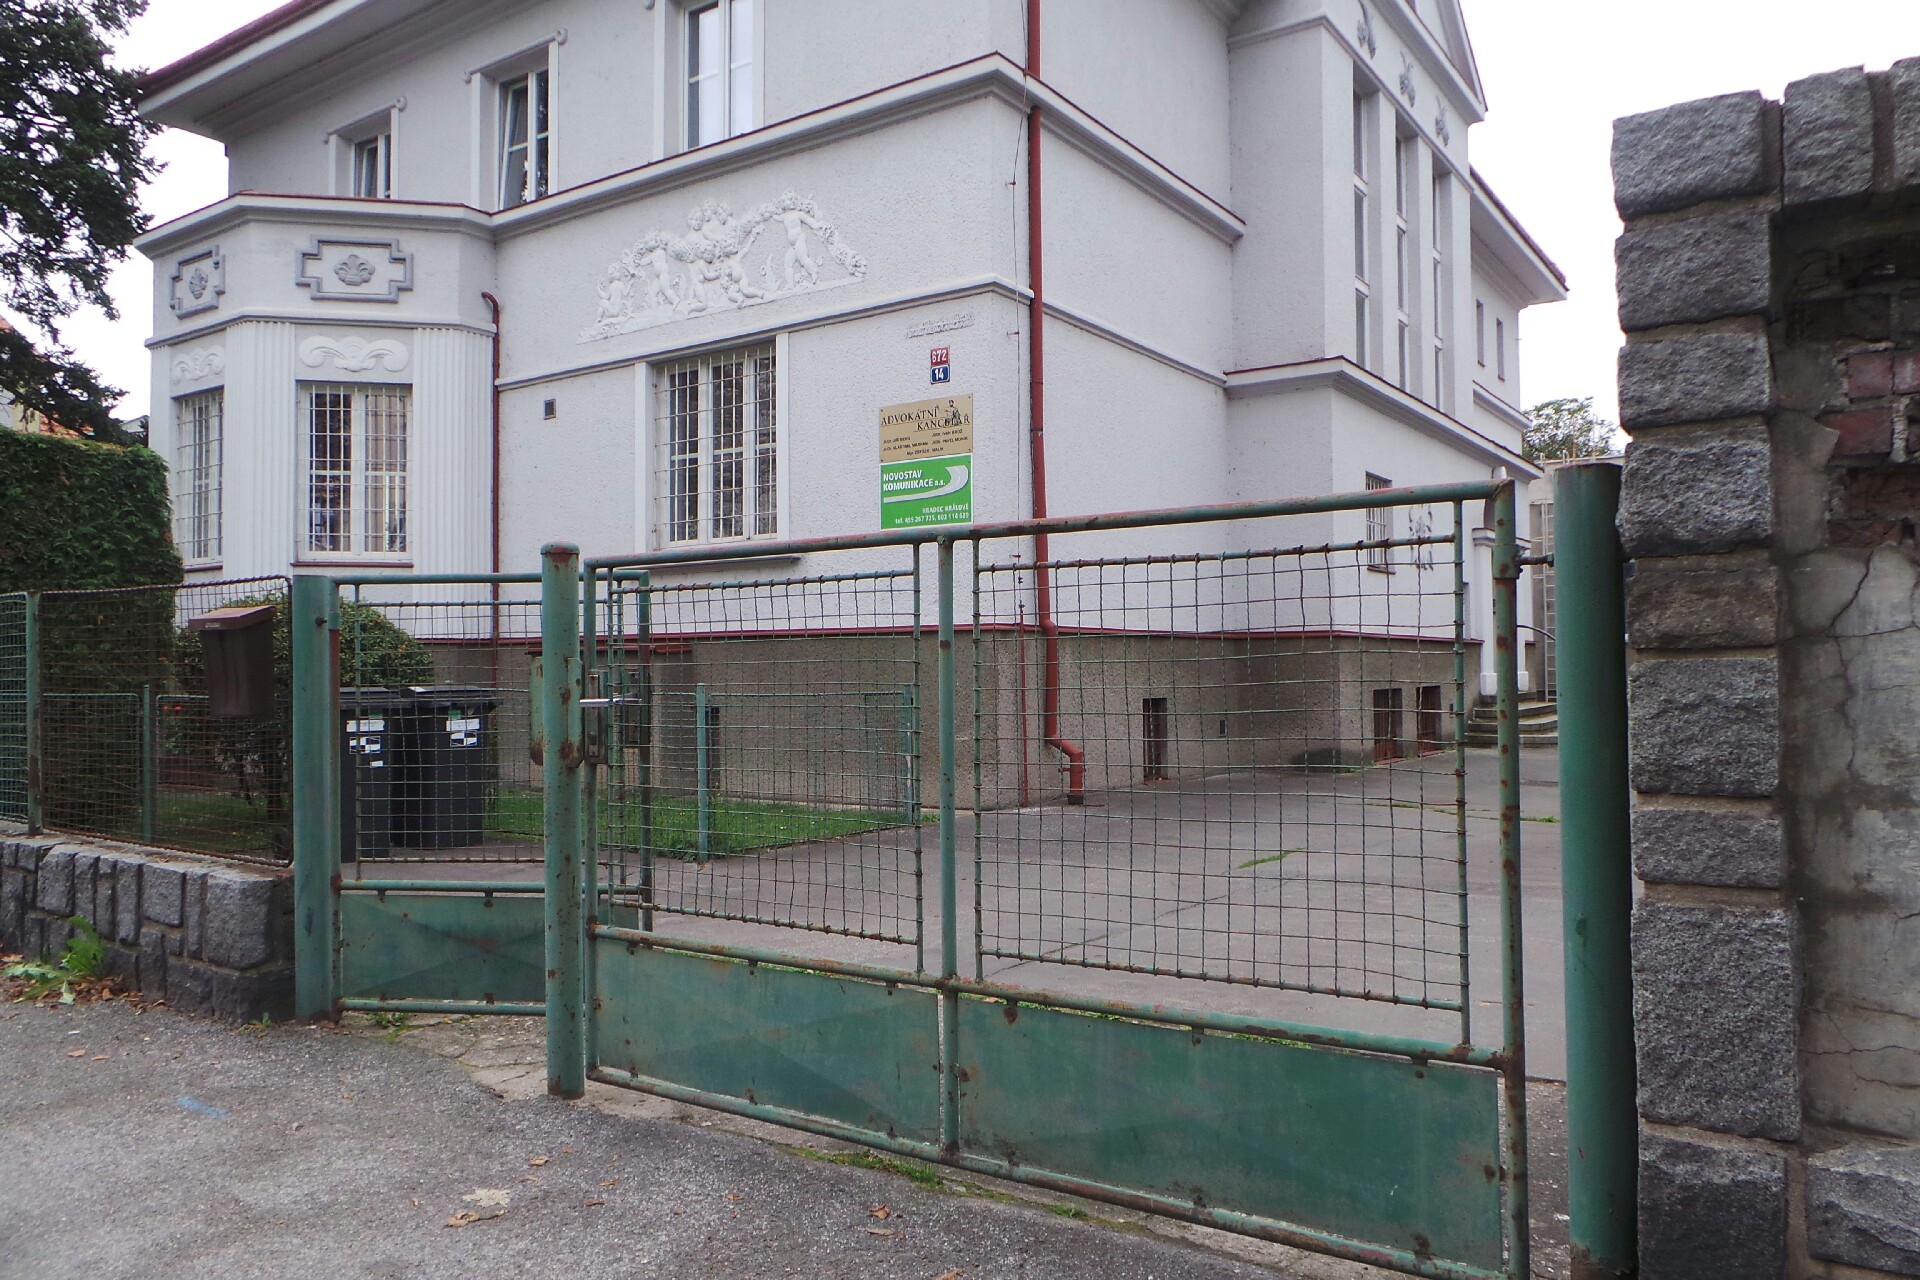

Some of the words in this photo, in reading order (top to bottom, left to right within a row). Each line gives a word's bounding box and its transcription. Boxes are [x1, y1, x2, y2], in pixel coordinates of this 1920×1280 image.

[931, 349, 947, 362] 672
[934, 367, 944, 380] 14
[881, 405, 939, 424] ADVOKÁTNÍ
[883, 469, 923, 482] NOVOSTAV
[883, 478, 934, 492] KOMUNIKACE
[922, 505, 944, 514] HRADEC
[944, 502, 969, 512] KRÁLOVÉ
